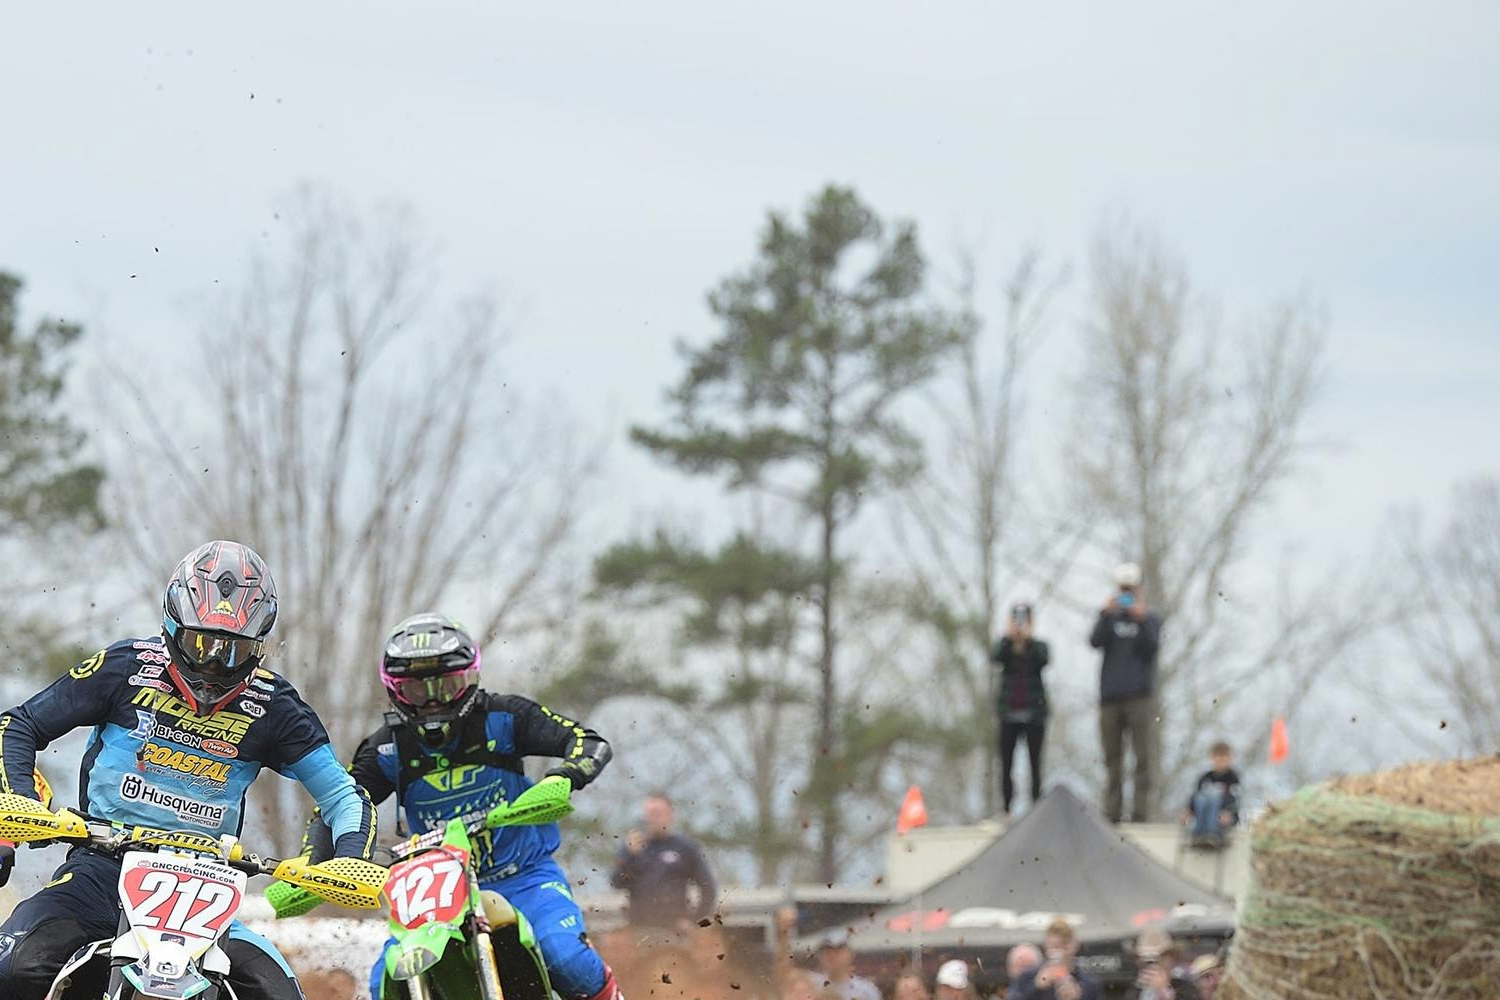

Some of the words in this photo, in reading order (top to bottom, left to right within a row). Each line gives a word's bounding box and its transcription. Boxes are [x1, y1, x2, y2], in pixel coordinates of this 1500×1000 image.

[175, 718, 245, 745] RACING
[143, 743, 232, 783] COASTAL
[141, 786, 223, 820] Husqvarna
[132, 870, 236, 941] 212
[390, 859, 465, 926] 127
